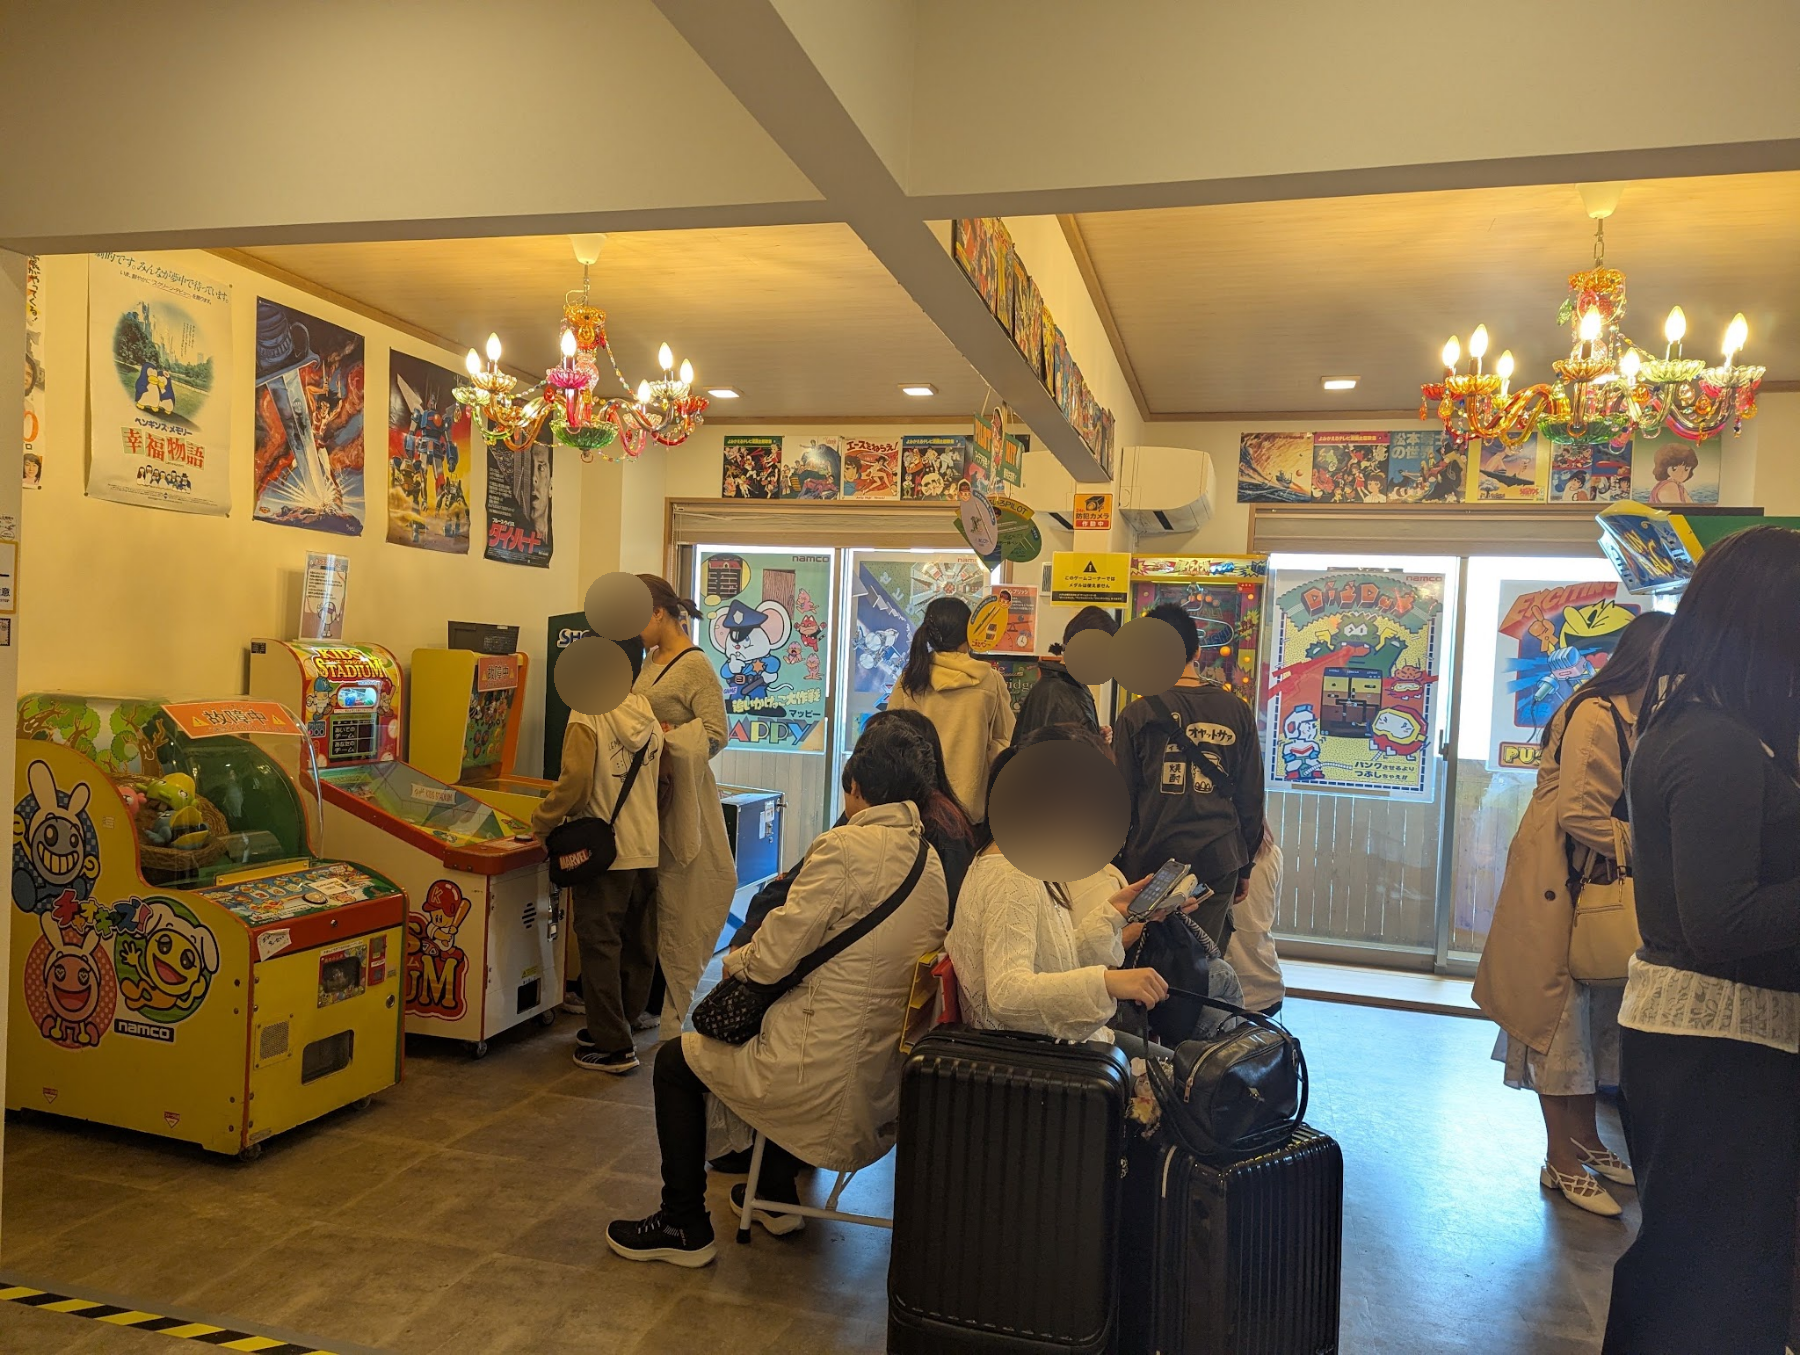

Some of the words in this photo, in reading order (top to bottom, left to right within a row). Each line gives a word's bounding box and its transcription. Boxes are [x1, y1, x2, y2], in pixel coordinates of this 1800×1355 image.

[123, 428, 205, 469] 幸福物語
[846, 440, 899, 453] エースをねらえ!
[791, 555, 830, 563] namco
[317, 648, 361, 660] KIDS
[314, 656, 384, 678] STADIUM
[486, 665, 510, 680] 故障中
[732, 688, 822, 713] 追いかけっこ大作戦
[202, 709, 268, 725] 故障中
[788, 709, 821, 719] マッピー
[728, 720, 816, 746] APPY
[1168, 764, 1182, 783] 焼酎
[1354, 761, 1415, 772] パンクさせるより
[560, 848, 591, 870] MARVEL
[117, 1021, 171, 1040] namco
